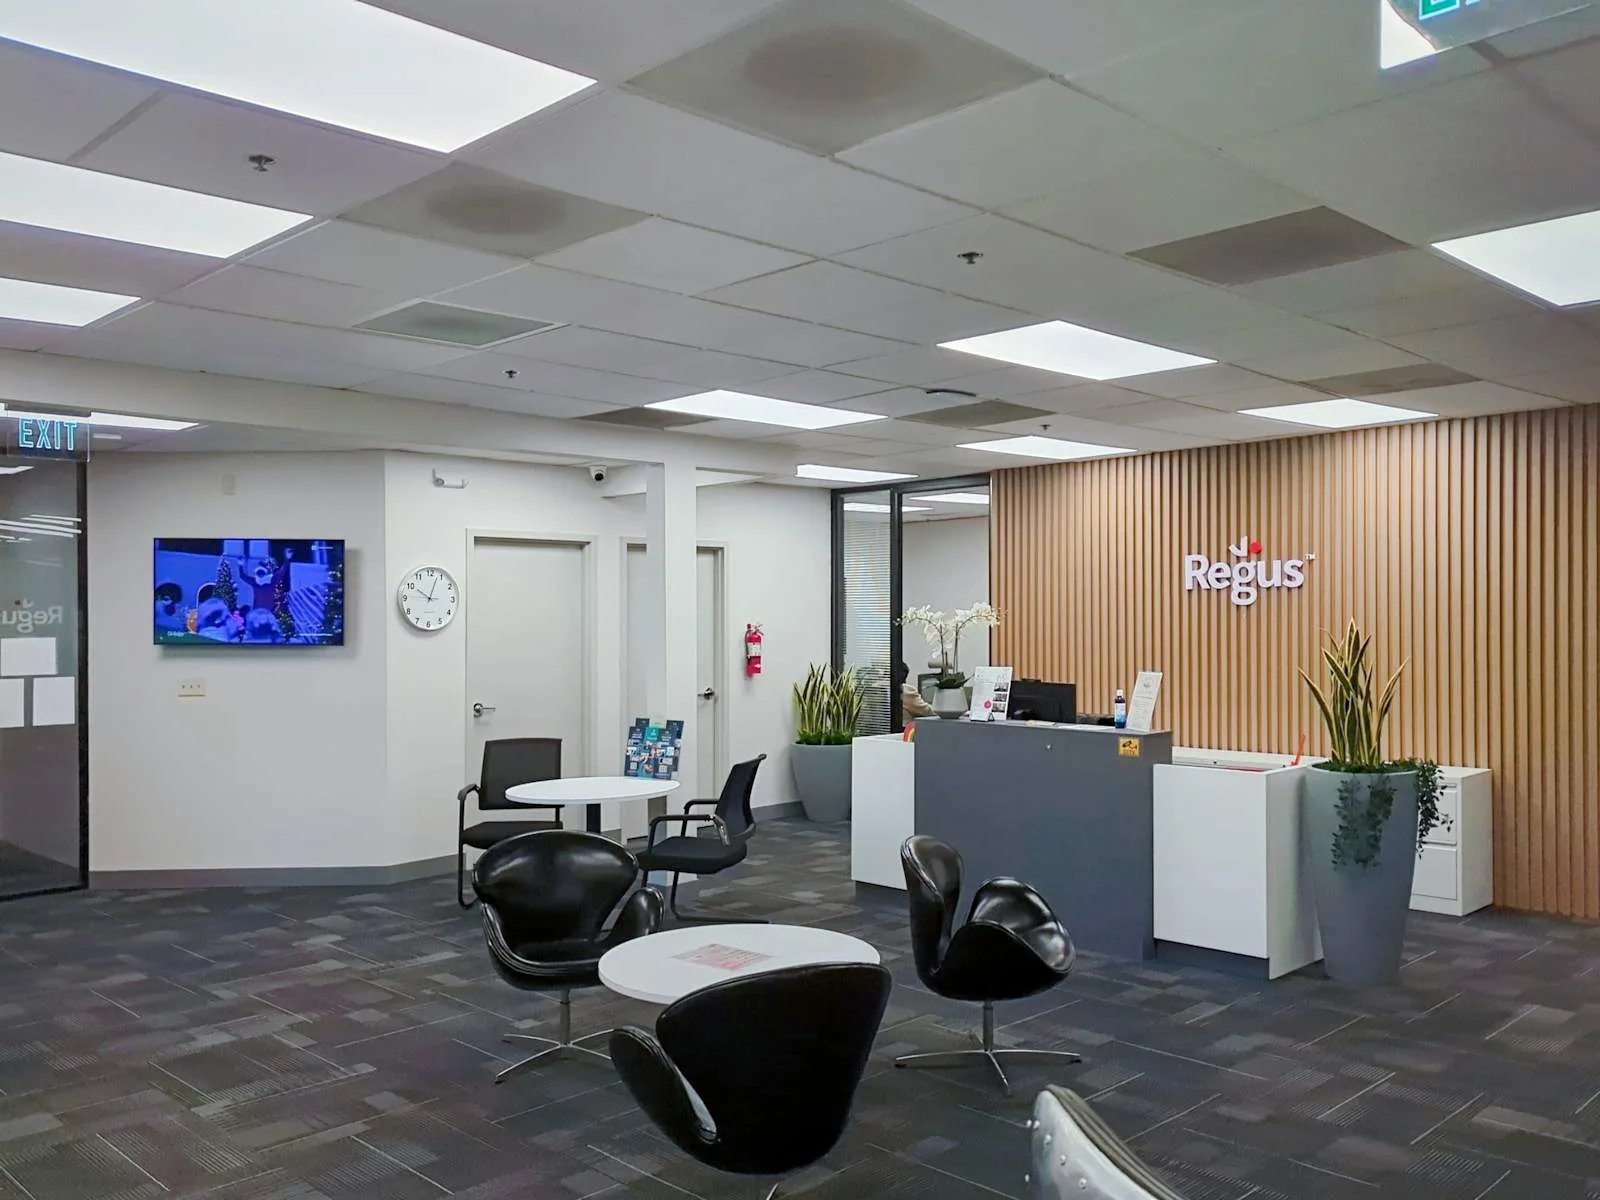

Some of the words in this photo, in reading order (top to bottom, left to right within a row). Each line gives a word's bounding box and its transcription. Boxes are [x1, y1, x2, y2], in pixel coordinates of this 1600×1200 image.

[18, 418, 78, 451] EXIT
[415, 573, 422, 581] 11
[426, 569, 435, 577] 12
[439, 573, 443, 581] 1
[1184, 551, 1305, 606] Regus
[407, 582, 415, 590] 10
[402, 594, 408, 602] 9
[406, 607, 411, 615] 8
[415, 617, 420, 625] 7
[438, 617, 443, 625] 5
